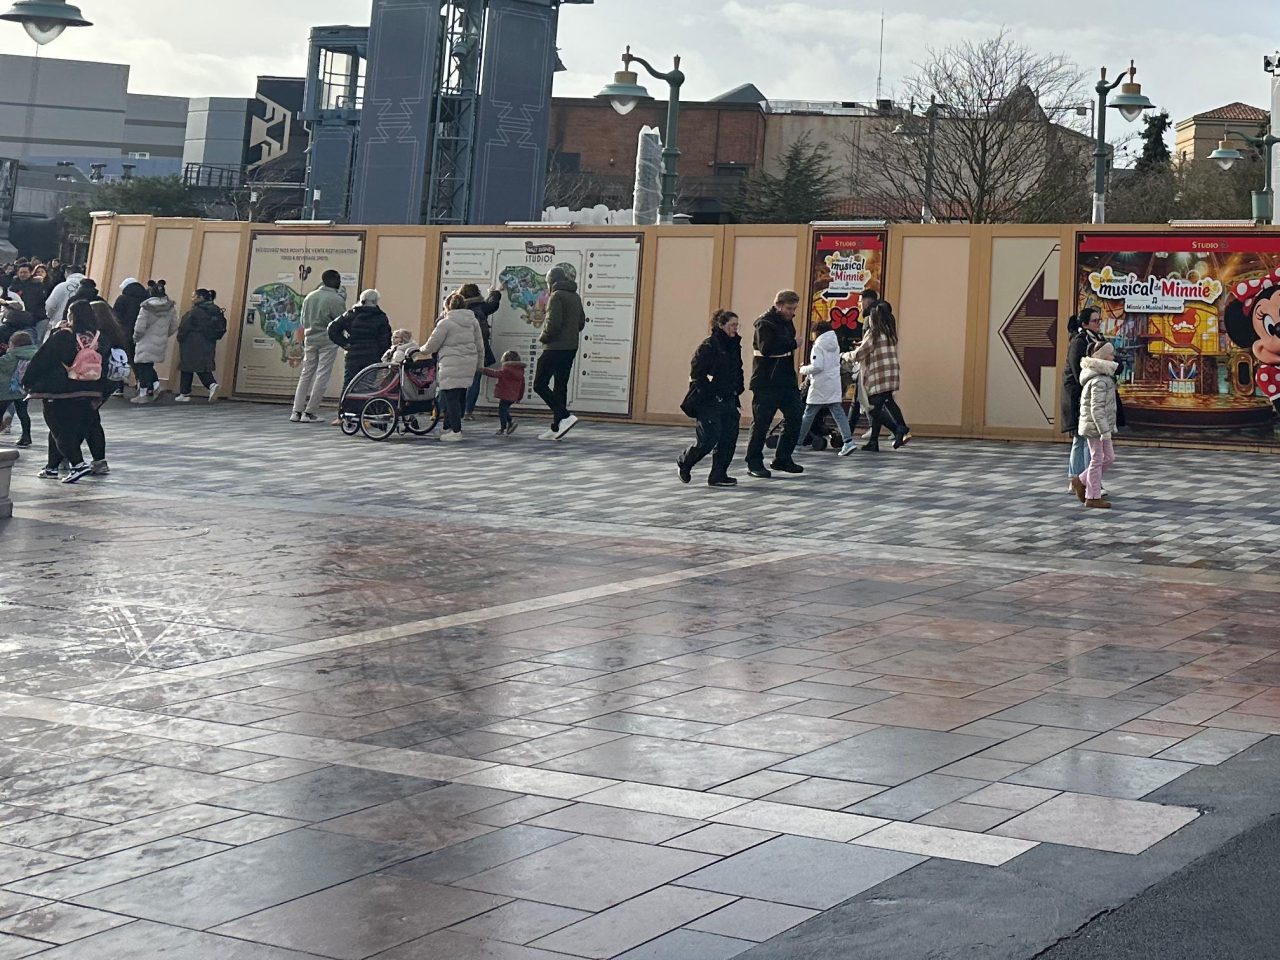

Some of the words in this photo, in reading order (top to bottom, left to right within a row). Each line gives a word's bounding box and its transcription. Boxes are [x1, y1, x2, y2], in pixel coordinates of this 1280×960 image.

[1192, 241, 1219, 249] STUDIO
[525, 255, 553, 263] STUDIOS
[831, 258, 865, 271] musical
[835, 270, 865, 281] Minnie
[1099, 278, 1154, 296] musical
[1161, 279, 1210, 298] Minnie
